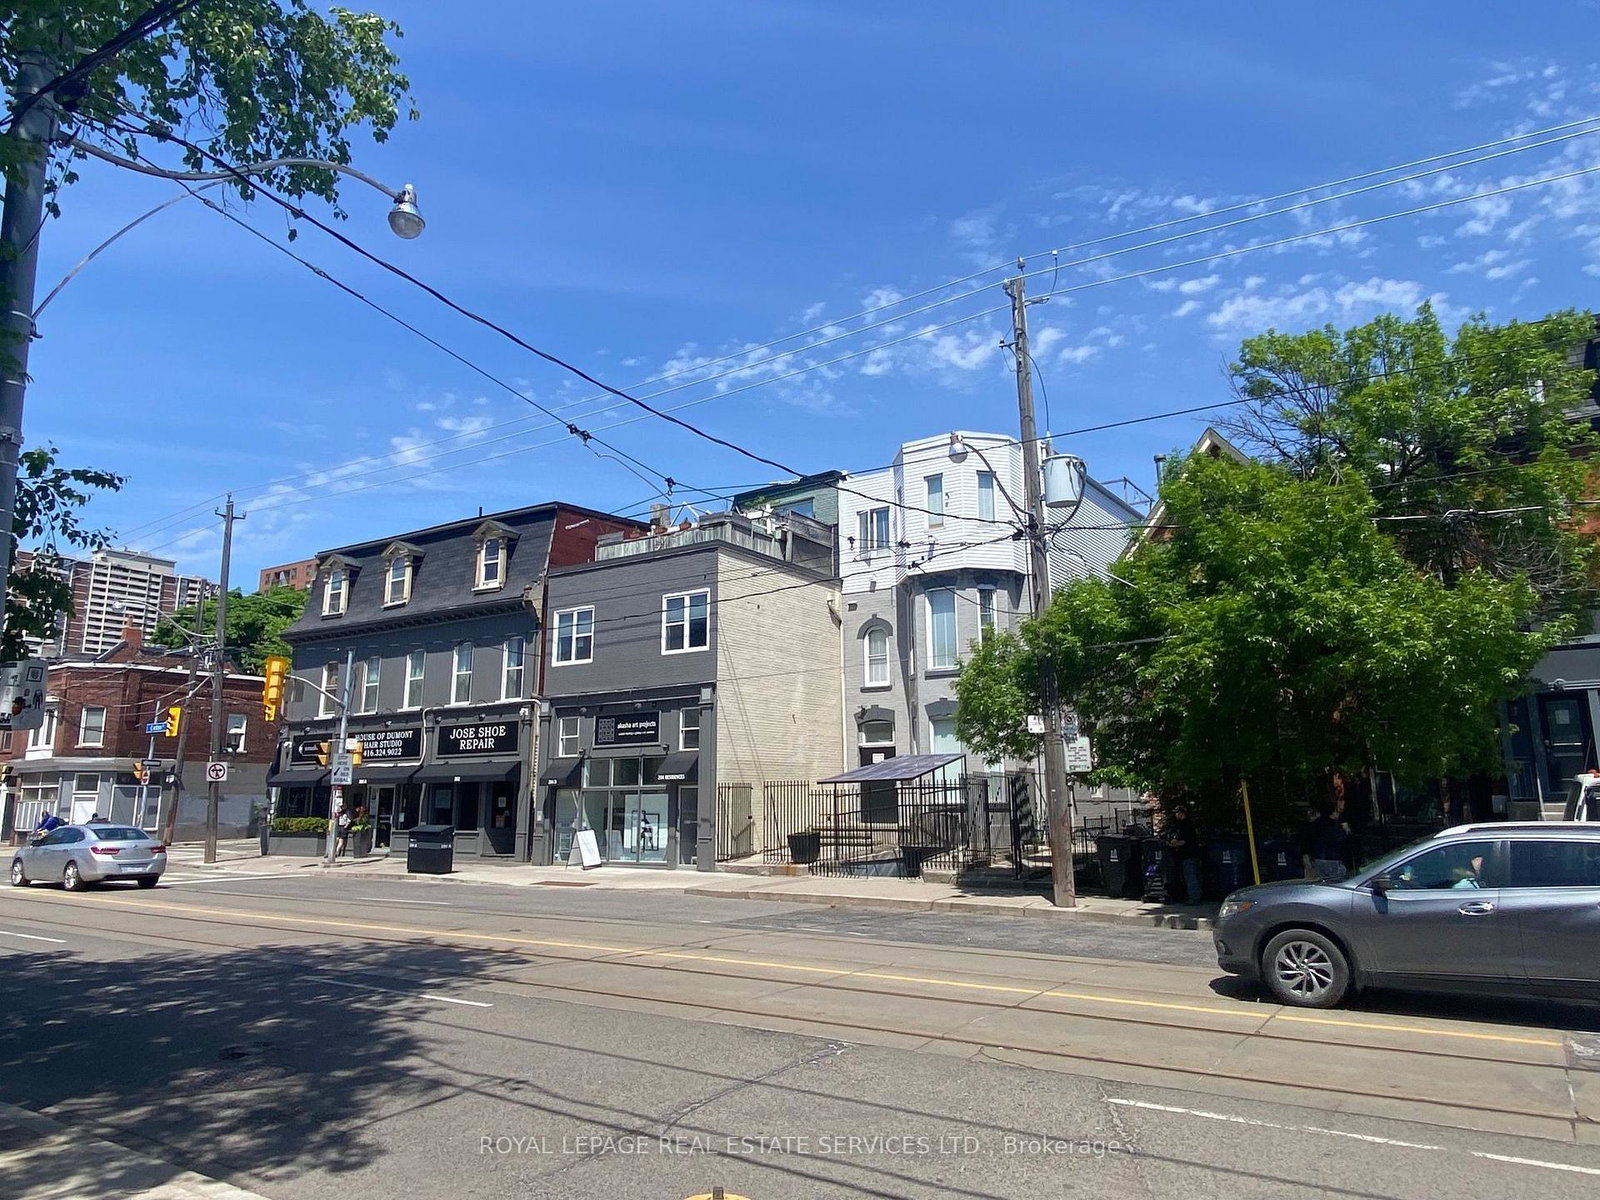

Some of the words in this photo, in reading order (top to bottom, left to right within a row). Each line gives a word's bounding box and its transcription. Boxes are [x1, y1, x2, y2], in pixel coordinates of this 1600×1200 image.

[355, 733, 376, 741] HOUSE
[376, 732, 386, 740] OF
[386, 730, 413, 740] DUMONT
[449, 727, 476, 740] JOSE
[478, 725, 506, 738] SHOE
[363, 741, 379, 749] HAIR
[379, 739, 403, 748] STUDIO
[459, 738, 495, 750] REPAIR
